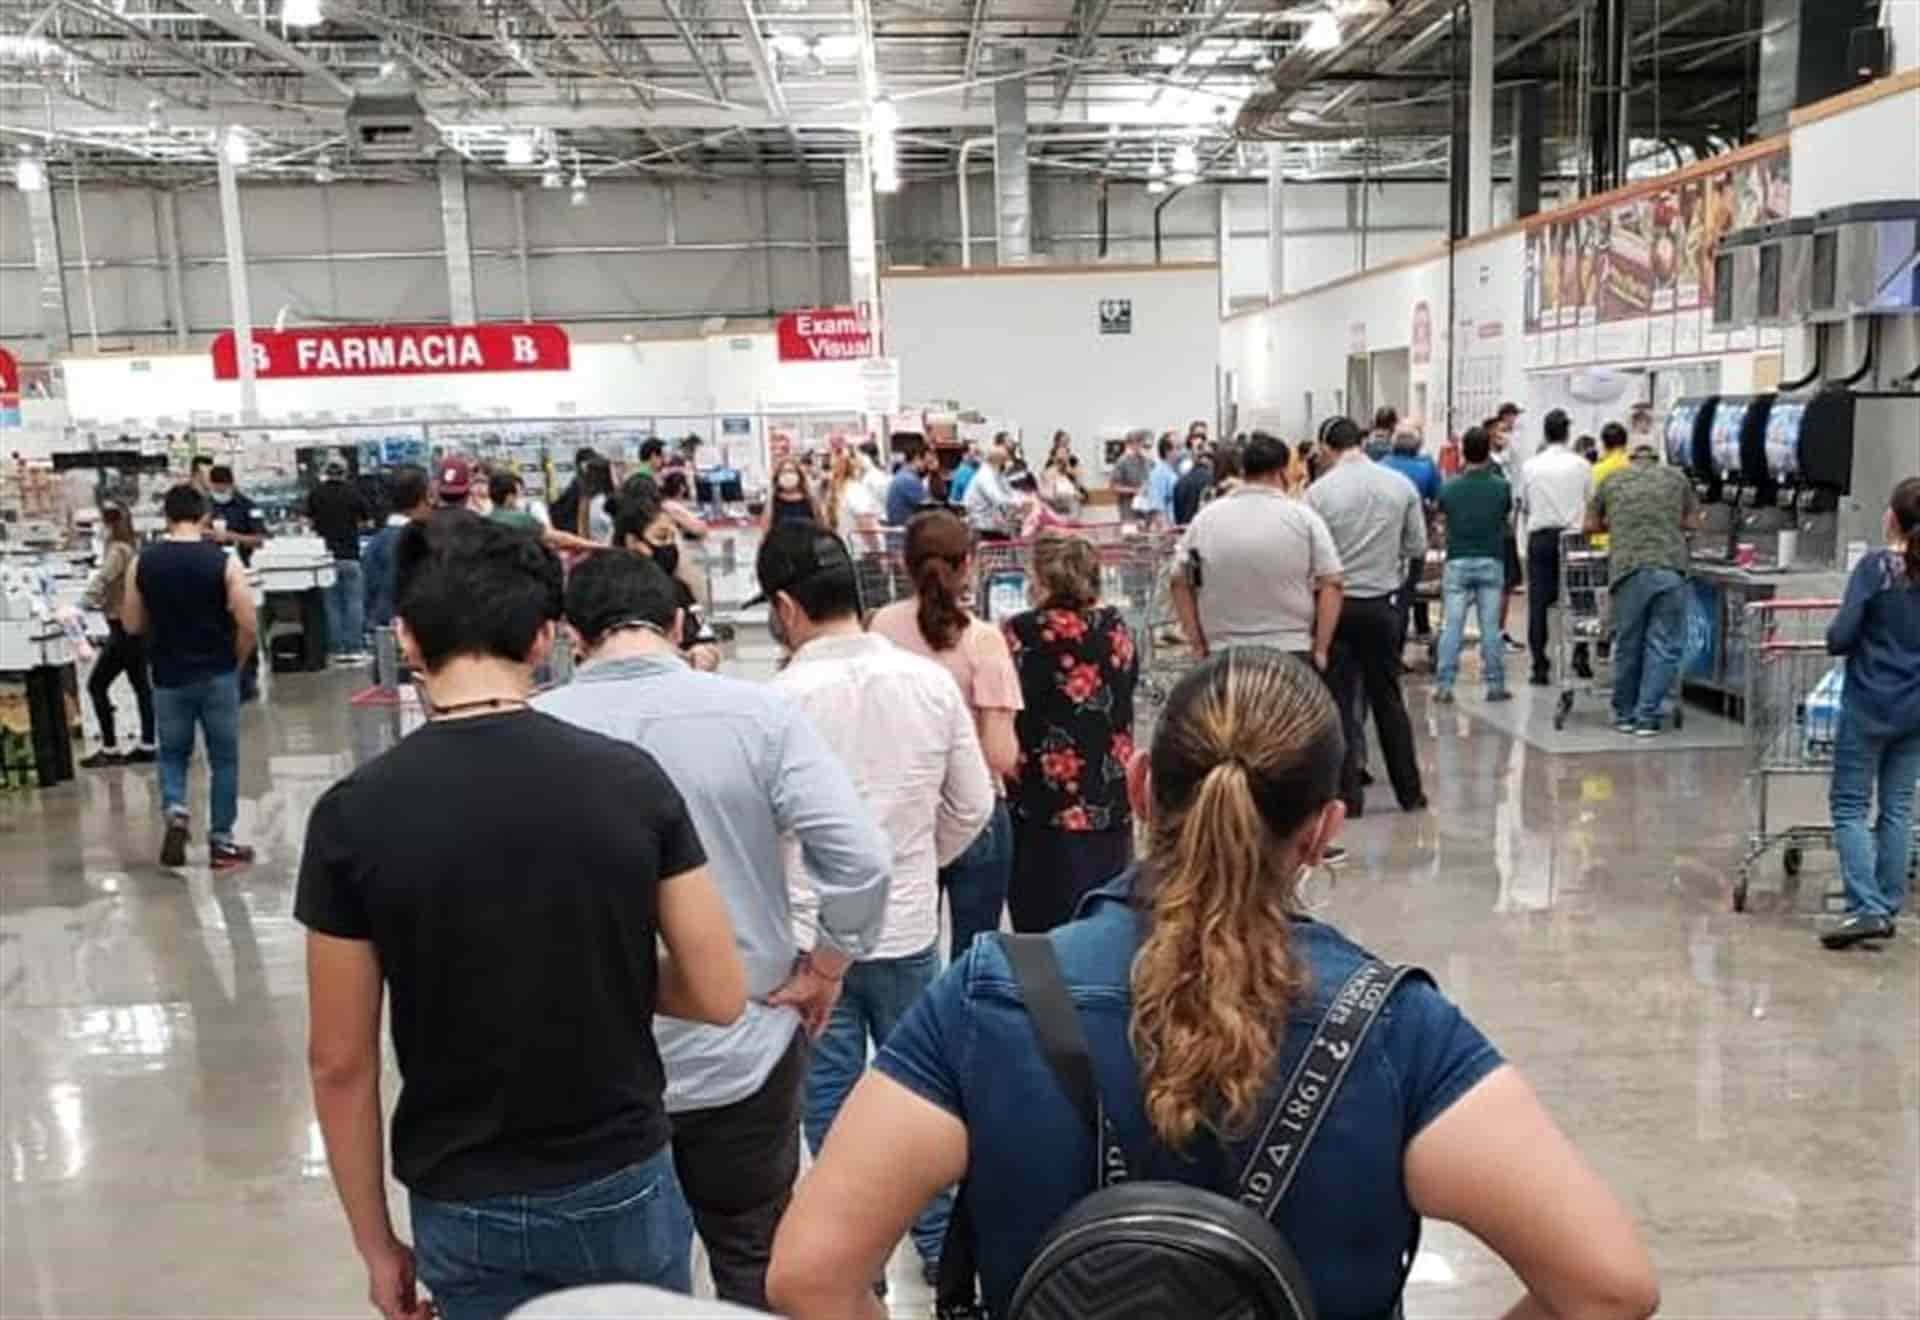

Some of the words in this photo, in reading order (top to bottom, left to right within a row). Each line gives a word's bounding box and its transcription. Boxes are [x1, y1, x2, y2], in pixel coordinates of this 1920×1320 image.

[797, 316, 868, 336] Exam
[297, 335, 484, 369] FARMACIA
[807, 338, 871, 357] Visual
[1281, 1069, 1327, 1132] 1981
